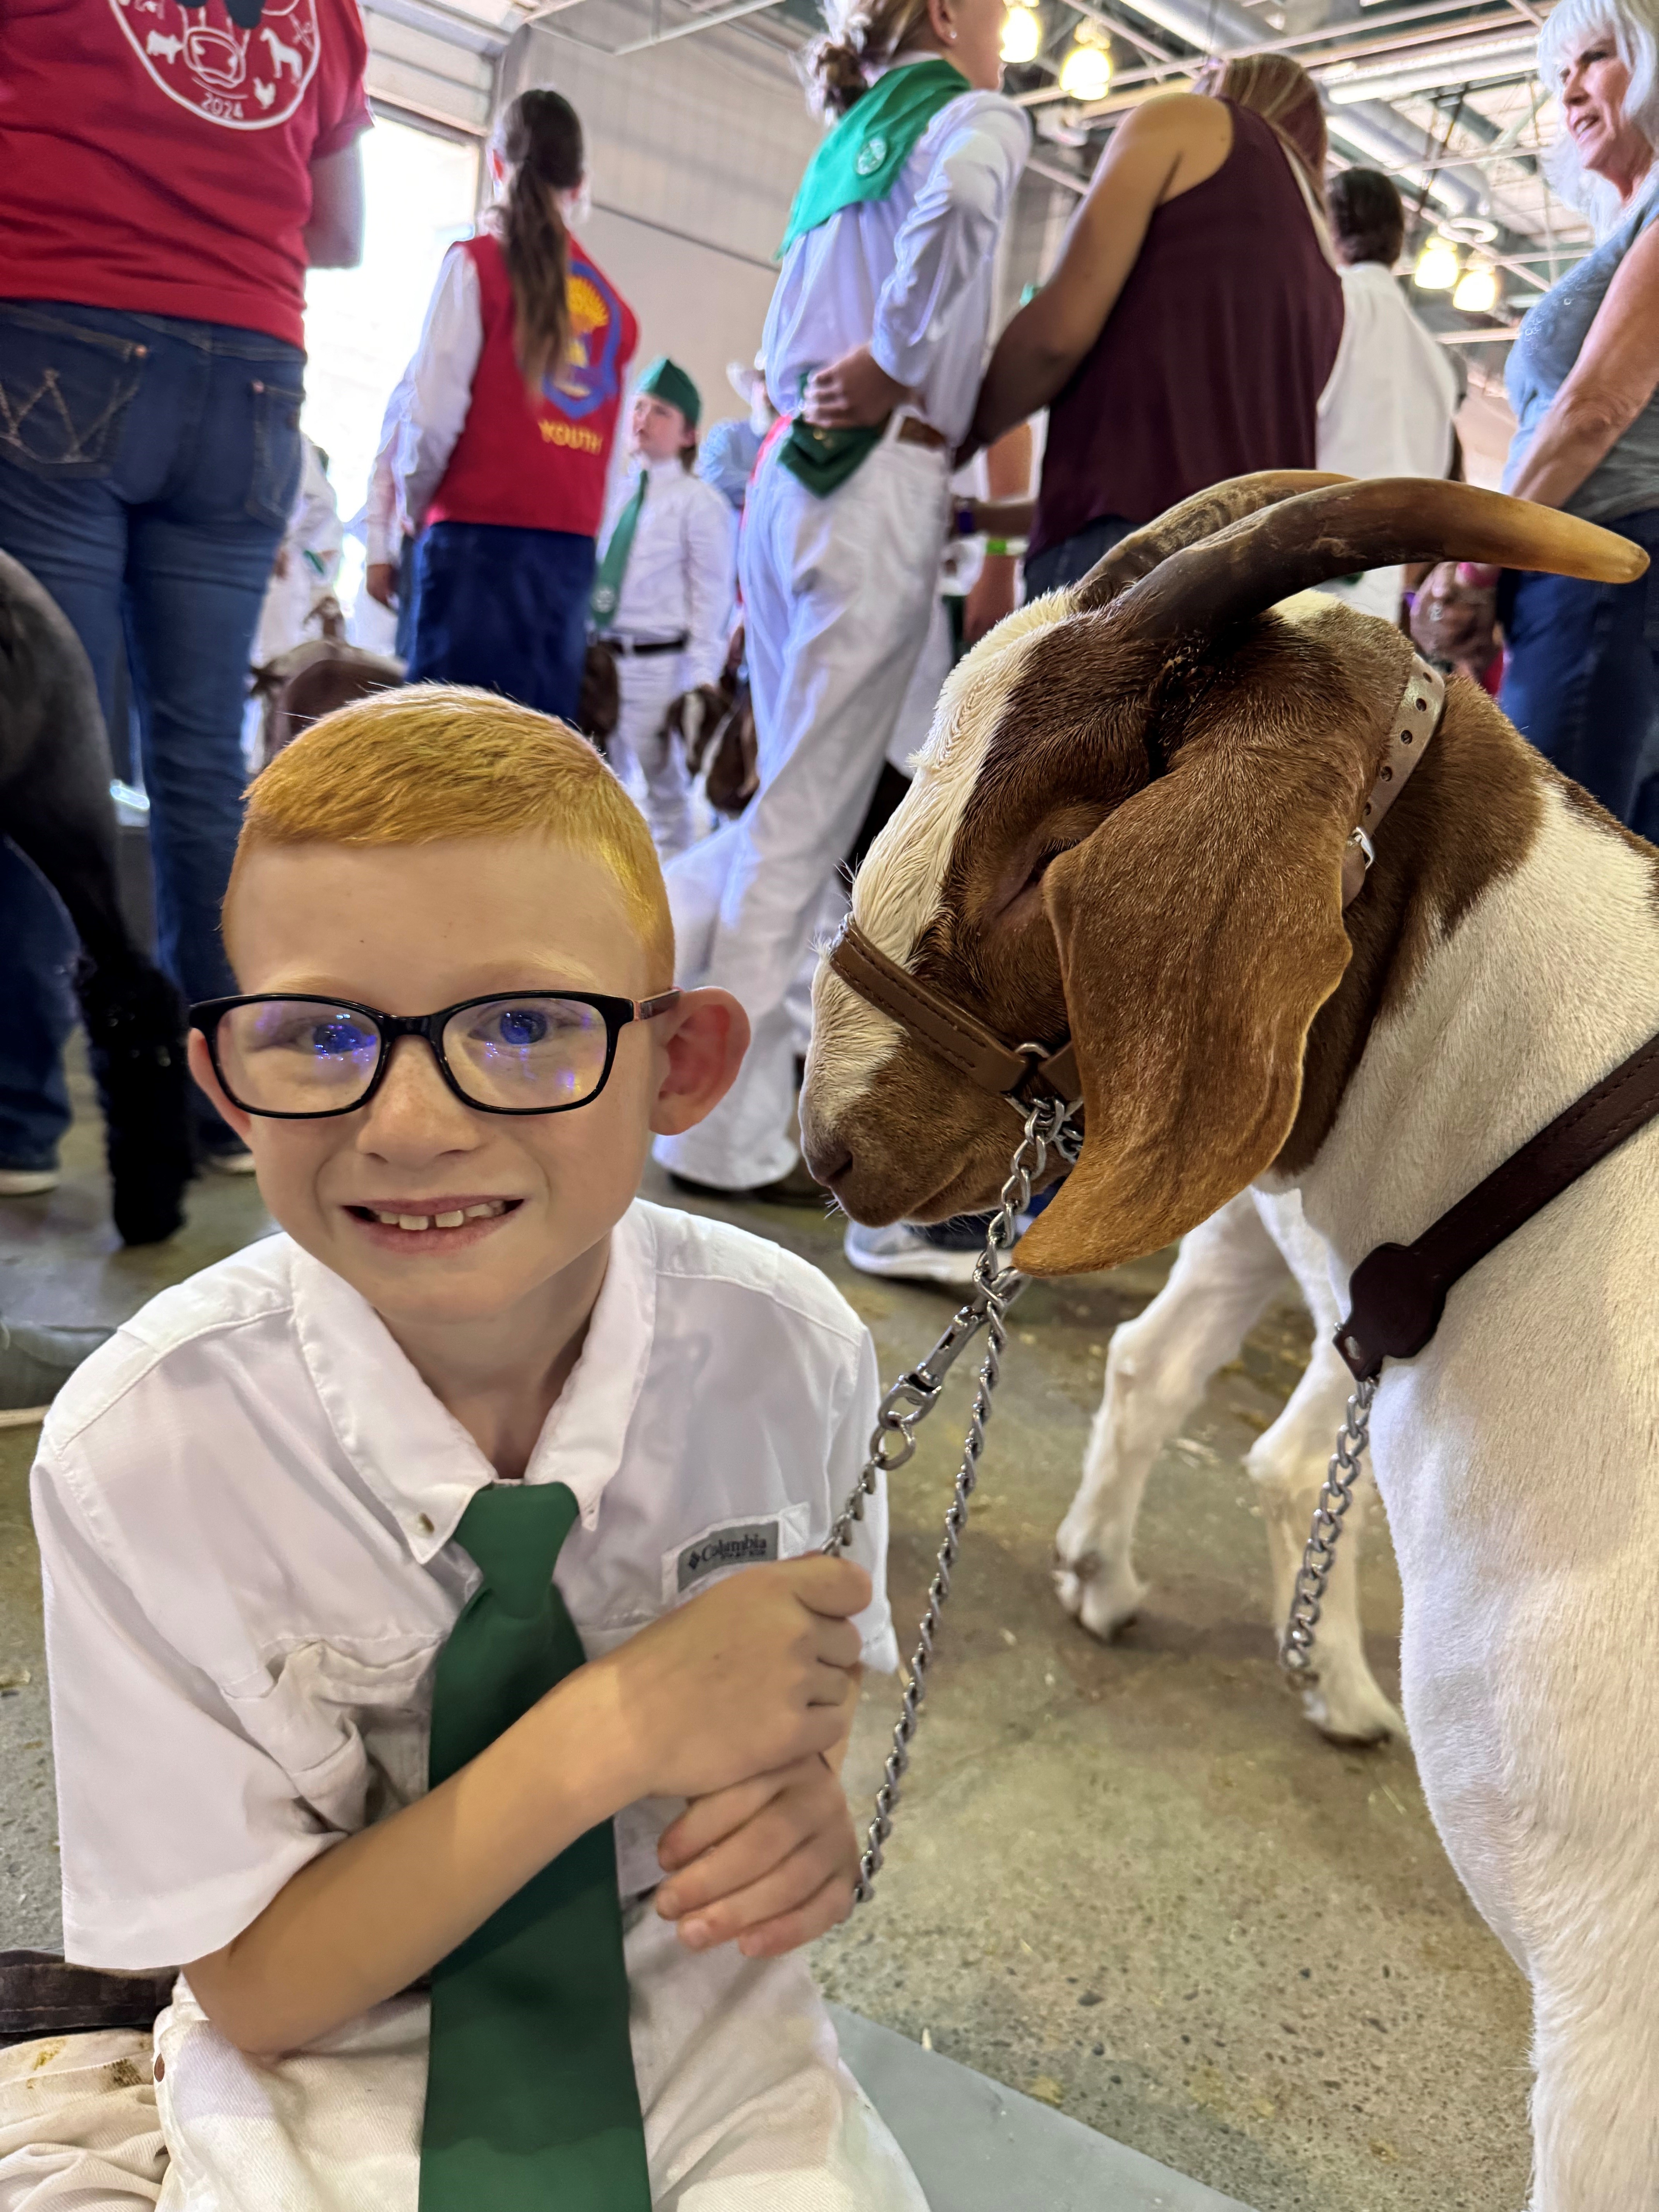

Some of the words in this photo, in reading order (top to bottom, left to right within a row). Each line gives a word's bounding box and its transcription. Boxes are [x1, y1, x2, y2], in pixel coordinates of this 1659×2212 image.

[201, 92, 244, 119] 2024
[538, 418, 603, 455] YOUTH
[701, 1533, 767, 1561] Columbia
